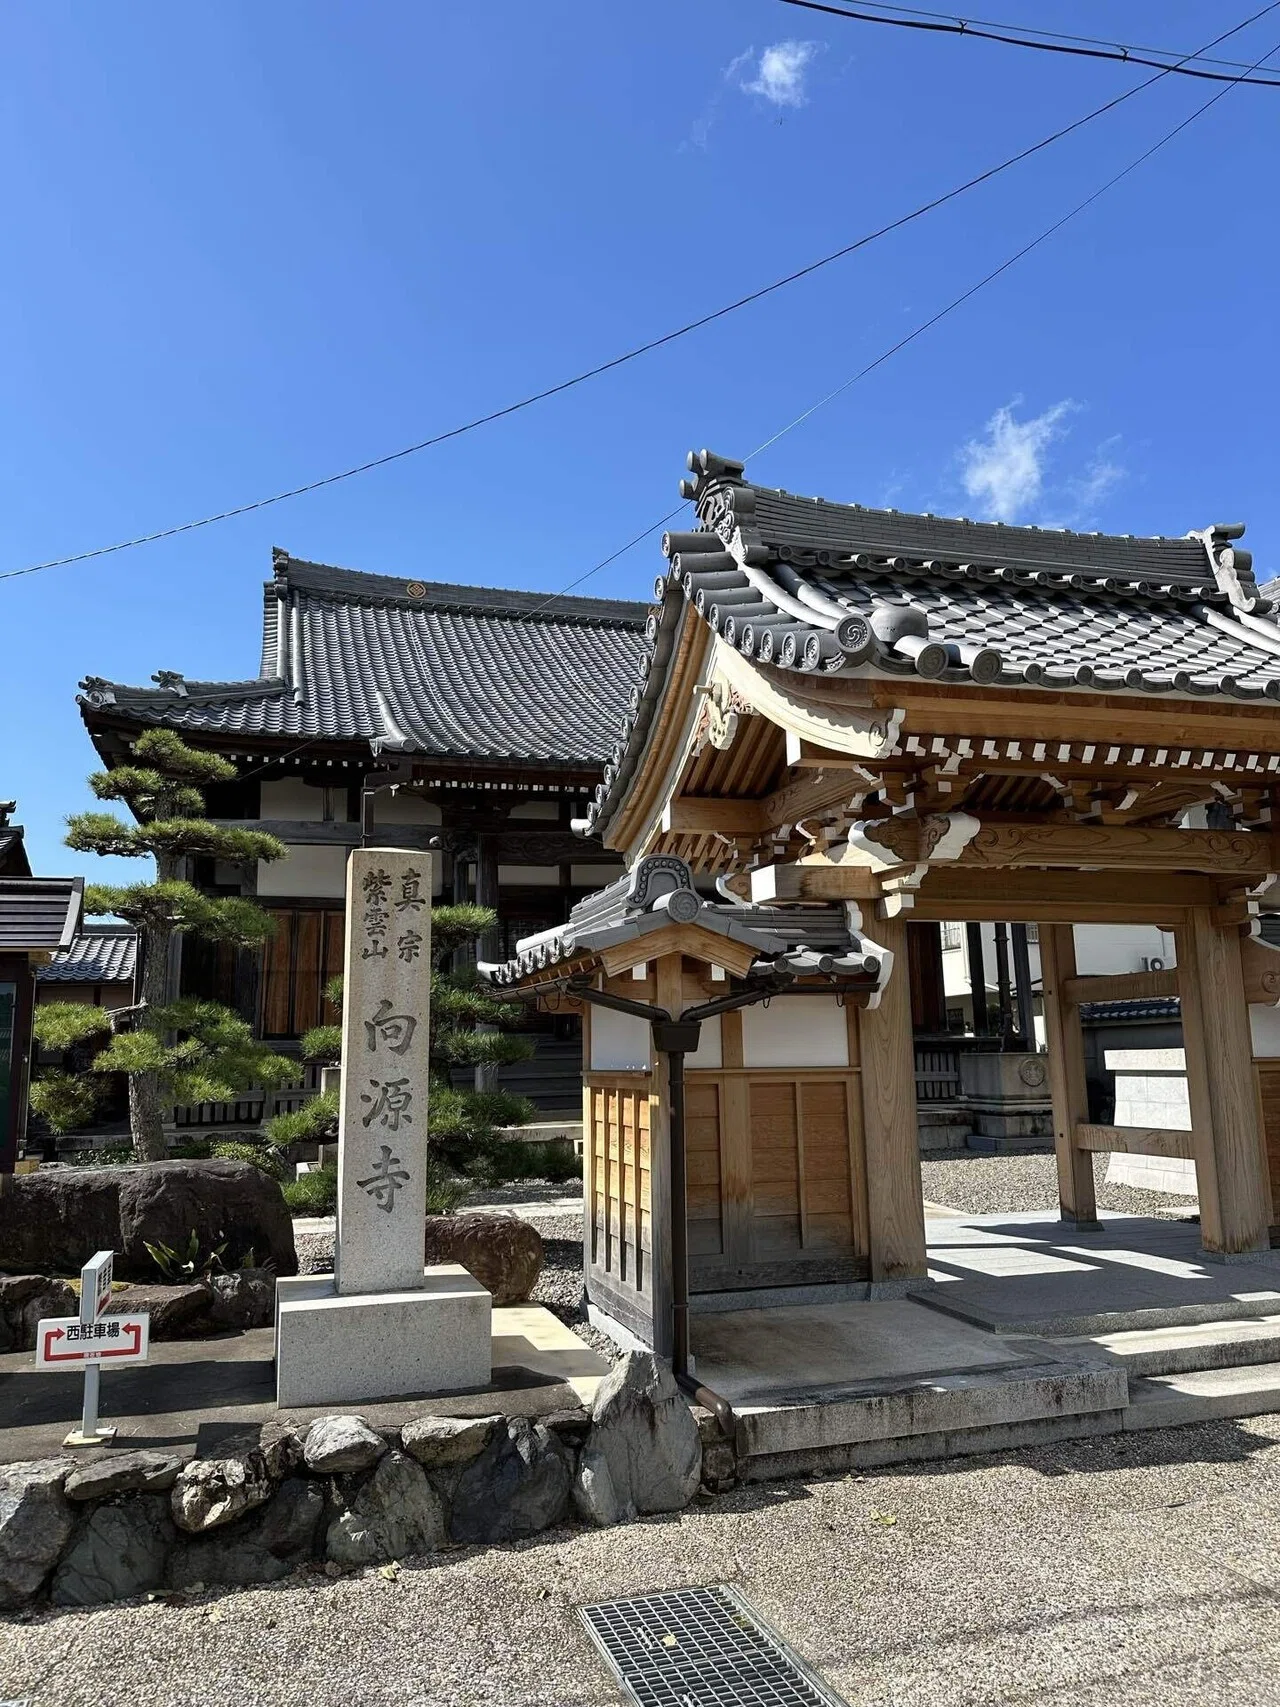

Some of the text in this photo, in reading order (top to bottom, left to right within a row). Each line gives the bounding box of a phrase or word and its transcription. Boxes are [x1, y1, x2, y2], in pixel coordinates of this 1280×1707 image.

[361, 868, 393, 960] 紫雲山
[395, 868, 426, 963] 真宗
[356, 1000, 417, 1213] 向源寺
[66, 1322, 120, 1341] 西駐車場
